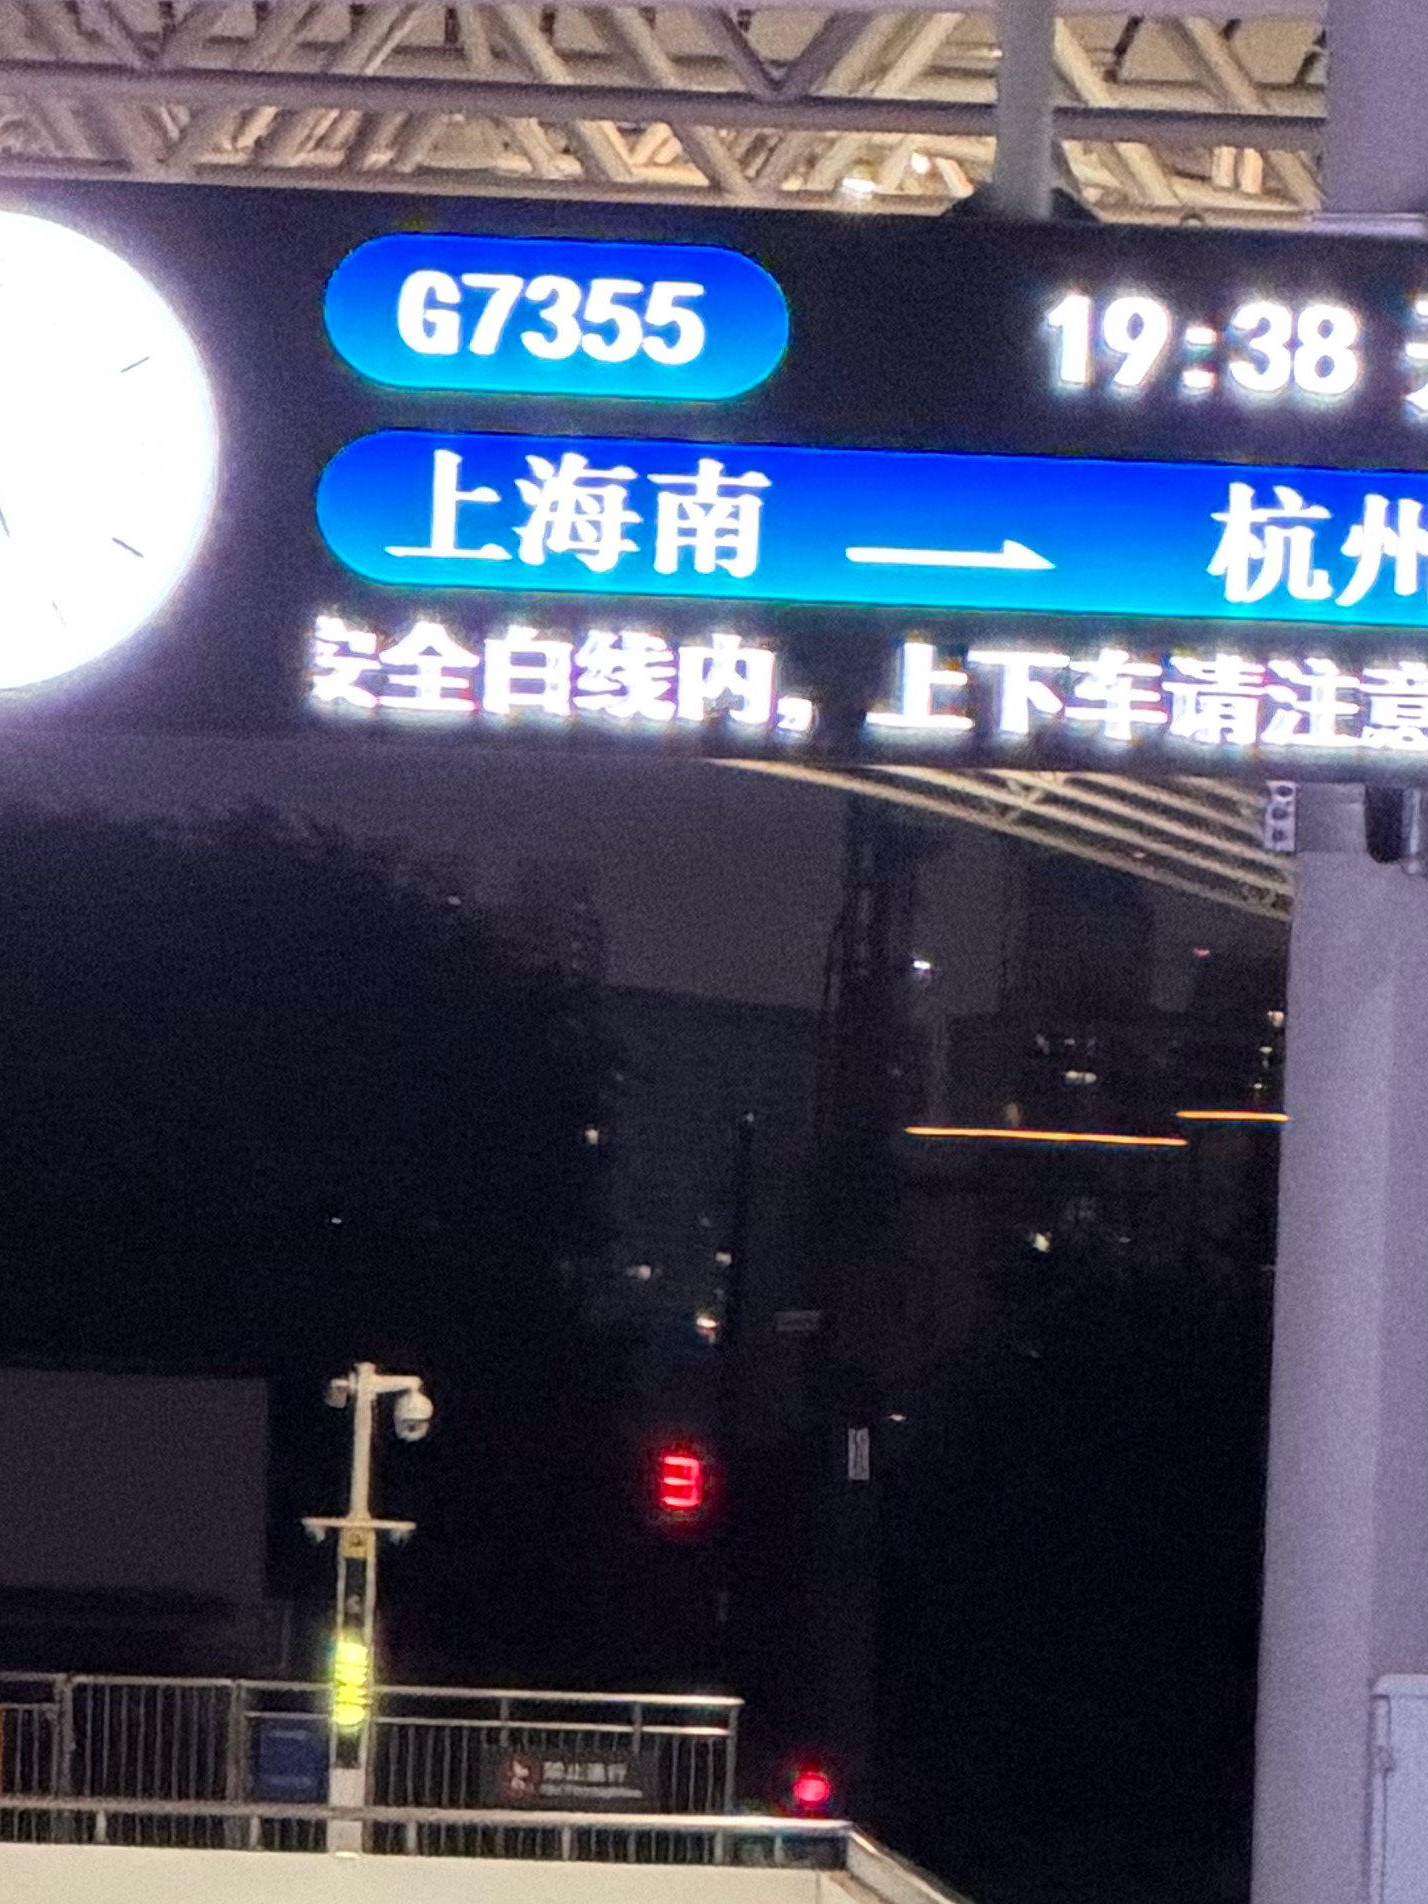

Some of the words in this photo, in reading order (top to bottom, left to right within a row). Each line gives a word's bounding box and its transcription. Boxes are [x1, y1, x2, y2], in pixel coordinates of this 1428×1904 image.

[397, 269, 706, 365] G7355
[1046, 295, 1360, 396] 19:38
[384, 449, 773, 579] 上海南
